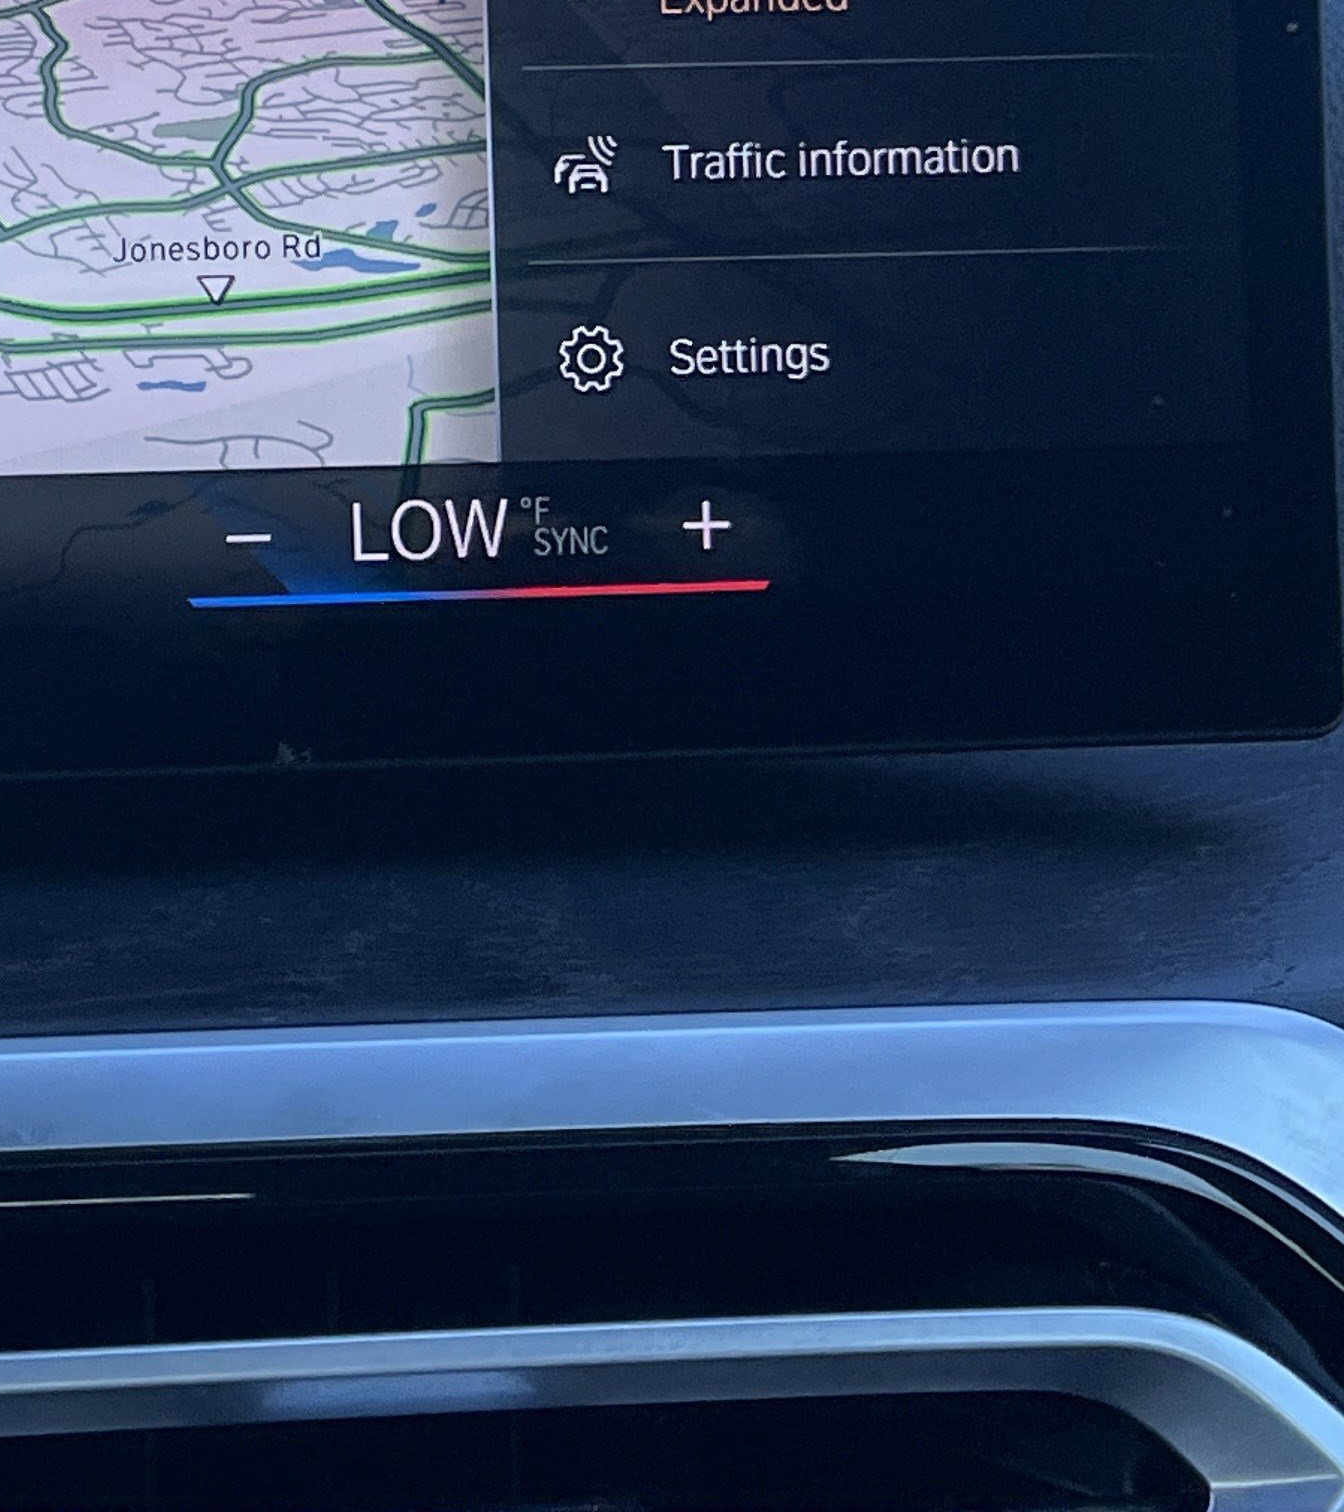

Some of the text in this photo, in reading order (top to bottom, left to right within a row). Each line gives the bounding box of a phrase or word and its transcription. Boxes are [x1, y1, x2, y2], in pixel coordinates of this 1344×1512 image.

[662, 139, 1018, 179] Traffic information
[113, 234, 321, 263] Jonesboro Rd
[671, 338, 829, 379] Settings
[353, 499, 507, 561] LOW
[534, 528, 609, 555] SYNC
